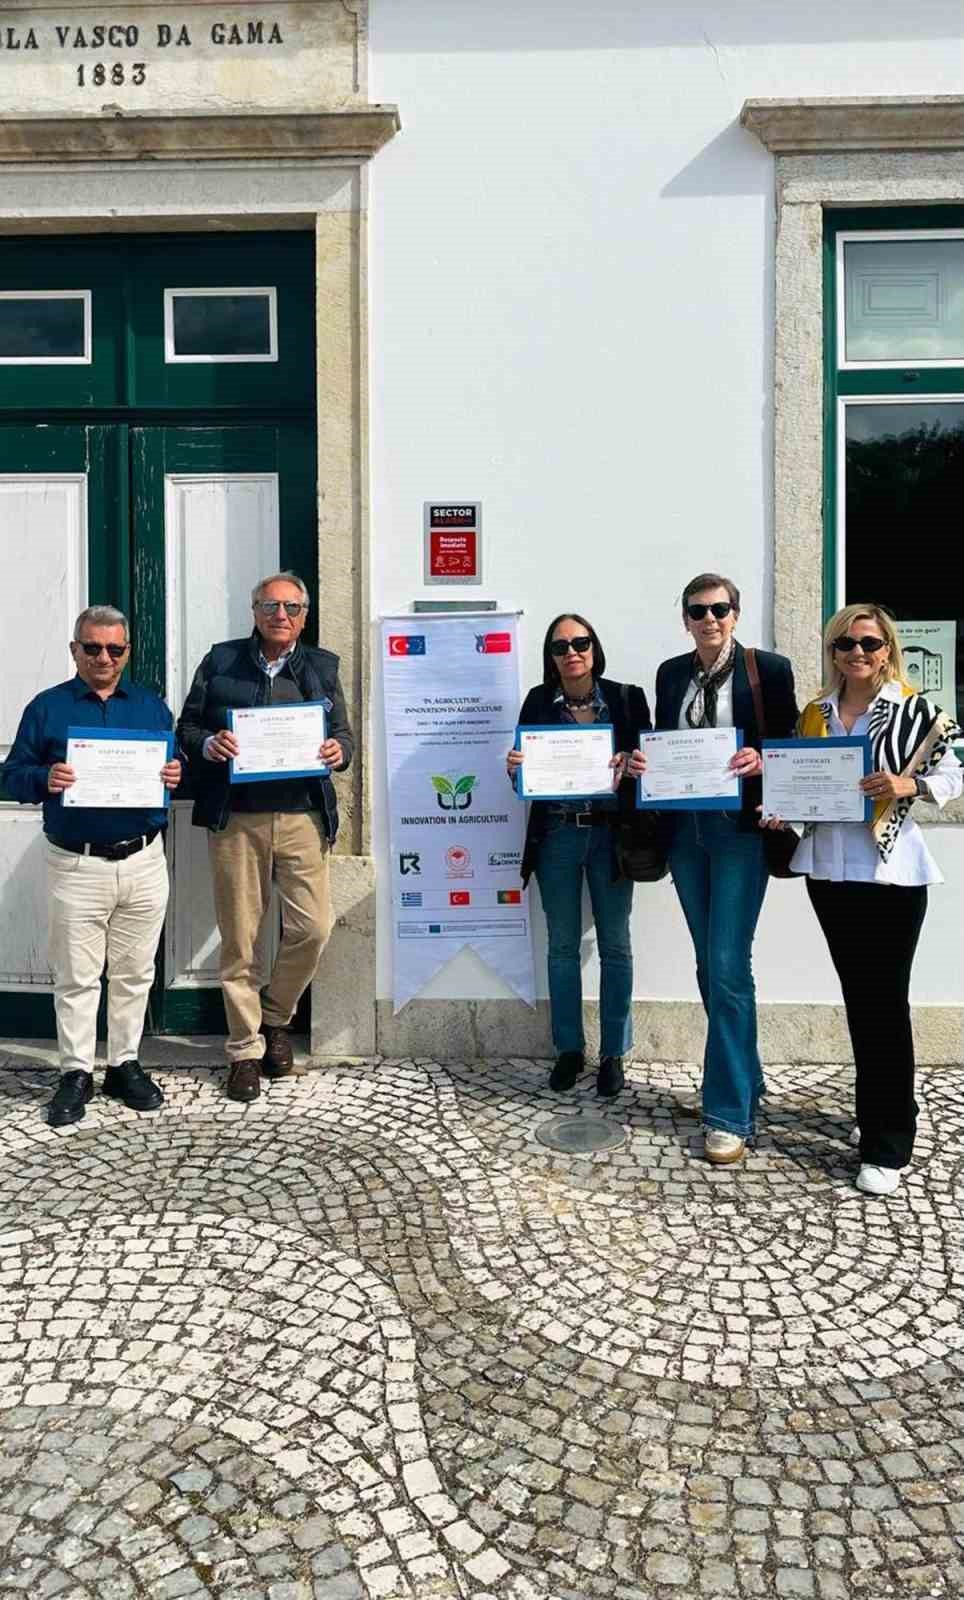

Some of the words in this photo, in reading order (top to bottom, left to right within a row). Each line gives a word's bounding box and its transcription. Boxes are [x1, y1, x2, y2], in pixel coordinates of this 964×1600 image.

[0, 27, 39, 49] LA
[55, 25, 140, 49] VASCO
[157, 24, 192, 47] DA
[211, 21, 284, 46] GAMA
[77, 63, 147, 87] 1883
[433, 508, 473, 517] SECTOR
[400, 816, 447, 825] INNOVATION
[448, 815, 457, 825] IN
[459, 814, 509, 824] AGRICULTURE
